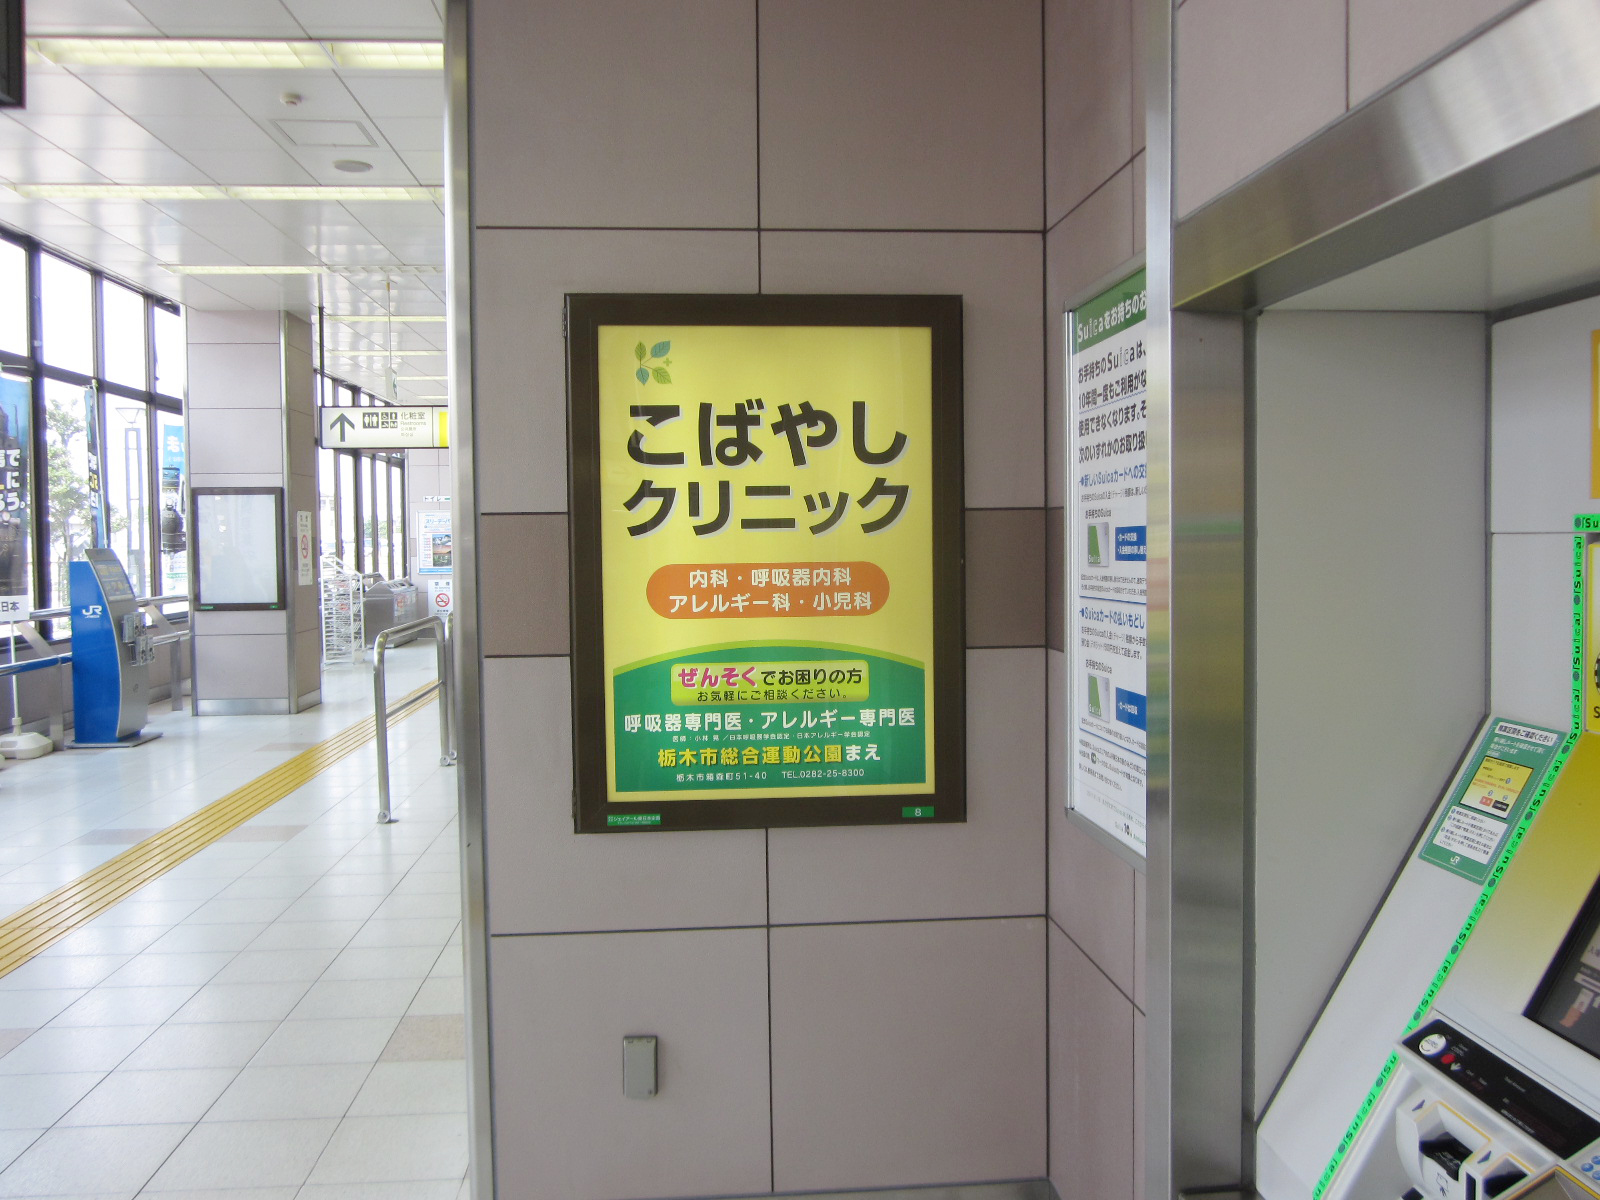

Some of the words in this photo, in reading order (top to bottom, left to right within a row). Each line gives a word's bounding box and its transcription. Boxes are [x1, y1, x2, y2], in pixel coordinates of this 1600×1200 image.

[626, 398, 909, 468] こばやし
[1079, 429, 1147, 464] 次のいずれかのお取り扱
[622, 477, 909, 538] クリニック
[689, 567, 852, 588] 内科・呼吸器内科
[0, 600, 20, 613] 日本
[82, 605, 102, 616] JR
[669, 592, 873, 612] アレルギー科・小児科
[1084, 606, 1145, 630] Suicaカードの払いもどし
[678, 666, 863, 688] ぜんそくでお困りの方
[696, 688, 848, 703] お気軽にご相談ください。
[624, 708, 916, 733] 呼吸器専門医・アレルギー専門医
[658, 744, 881, 768] 栃木市総合運動公園まえ
[781, 768, 866, 780] TEL.0282-25-8300
[914, 809, 922, 817] 8
[1450, 856, 1460, 864] JR
